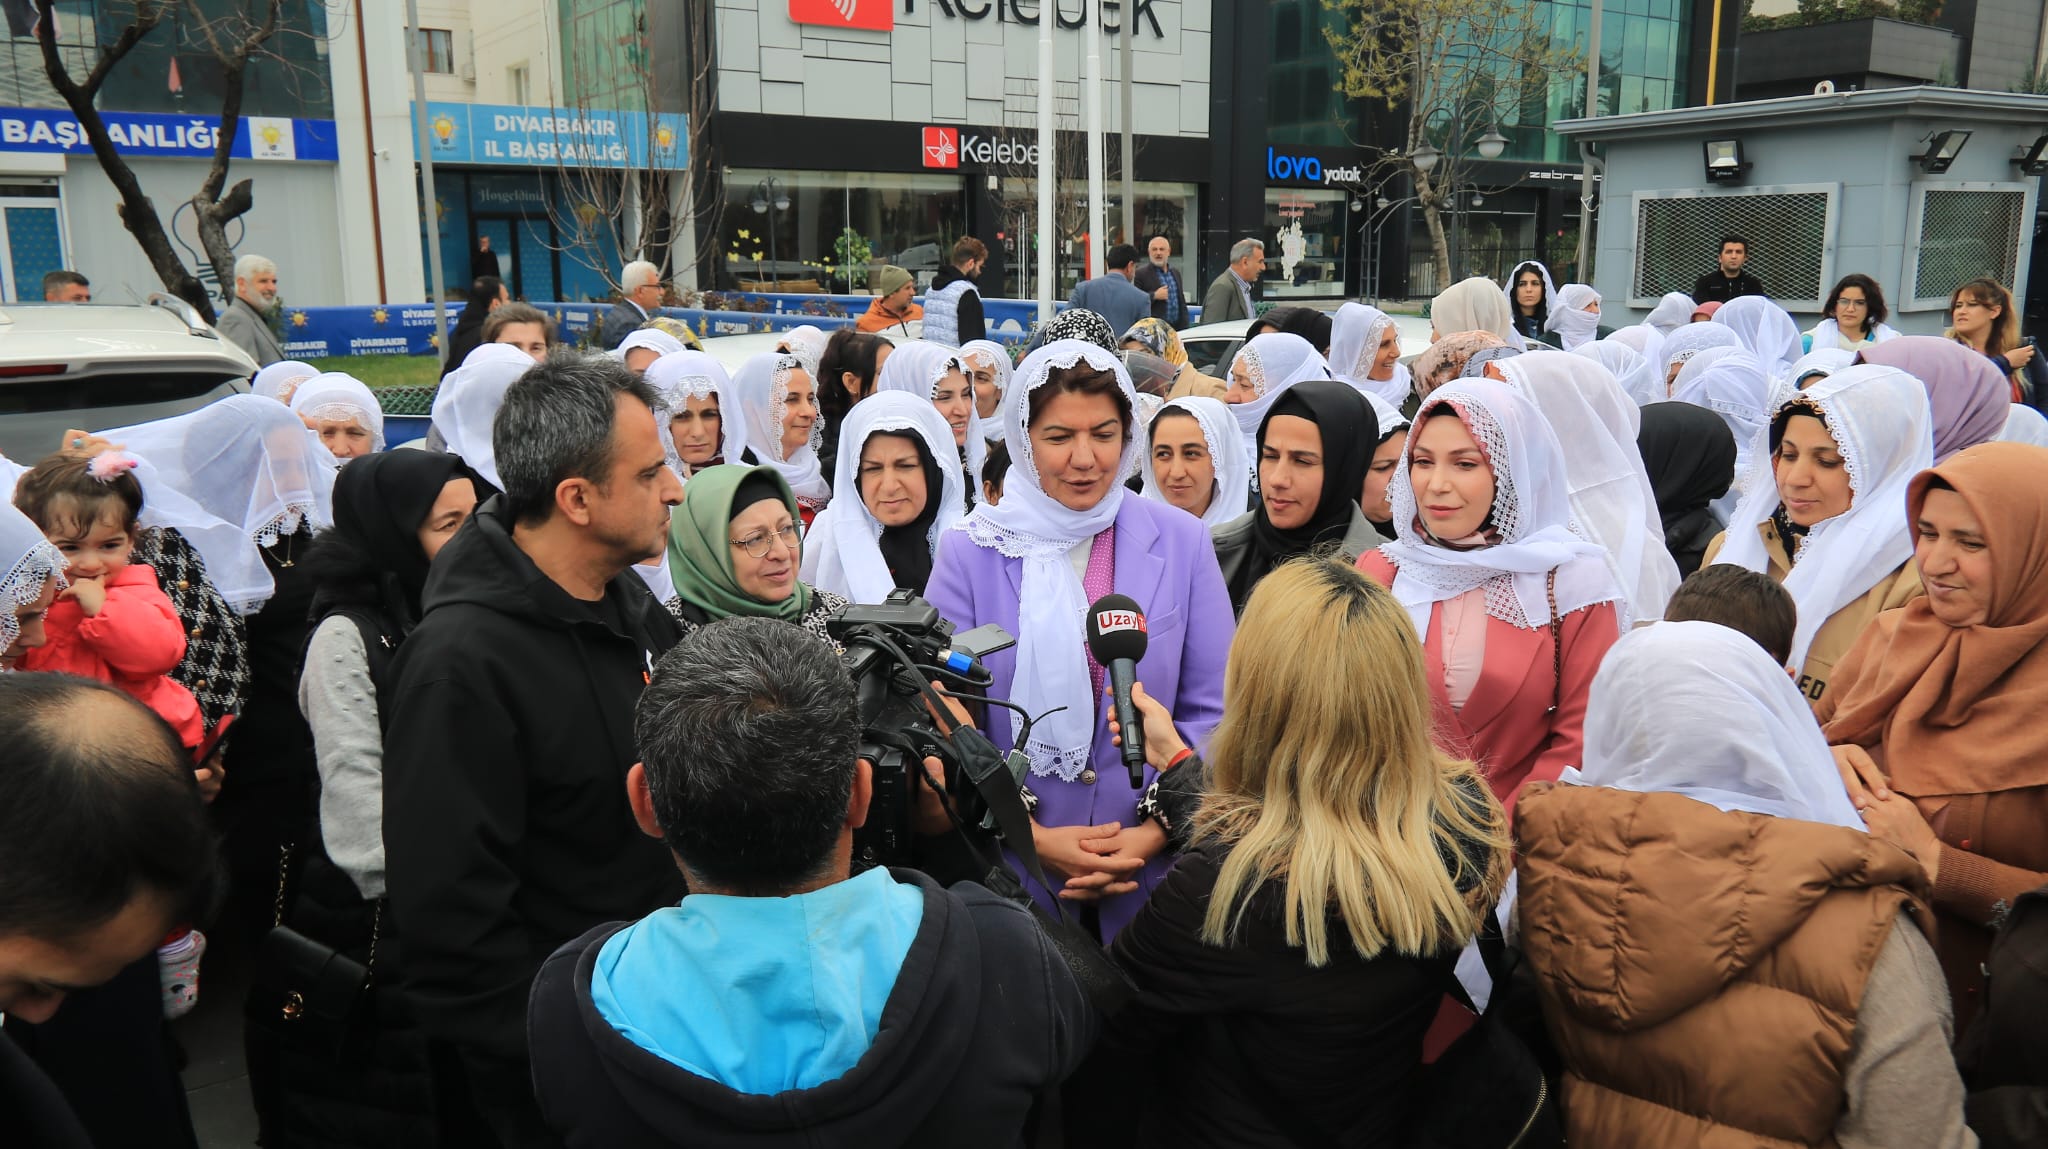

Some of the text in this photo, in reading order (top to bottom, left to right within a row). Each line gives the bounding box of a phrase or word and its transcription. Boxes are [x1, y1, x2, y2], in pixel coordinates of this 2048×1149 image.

[484, 140, 628, 160] İL BAŞKANLIĞI
[961, 134, 1040, 165] Kelebe
[1267, 146, 1361, 185] lova yatak
[1529, 169, 1603, 182] zebrao
[350, 337, 407, 347] DİYARBAKIR
[1100, 612, 1137, 628] Uzay
[1797, 674, 1826, 700] ED
